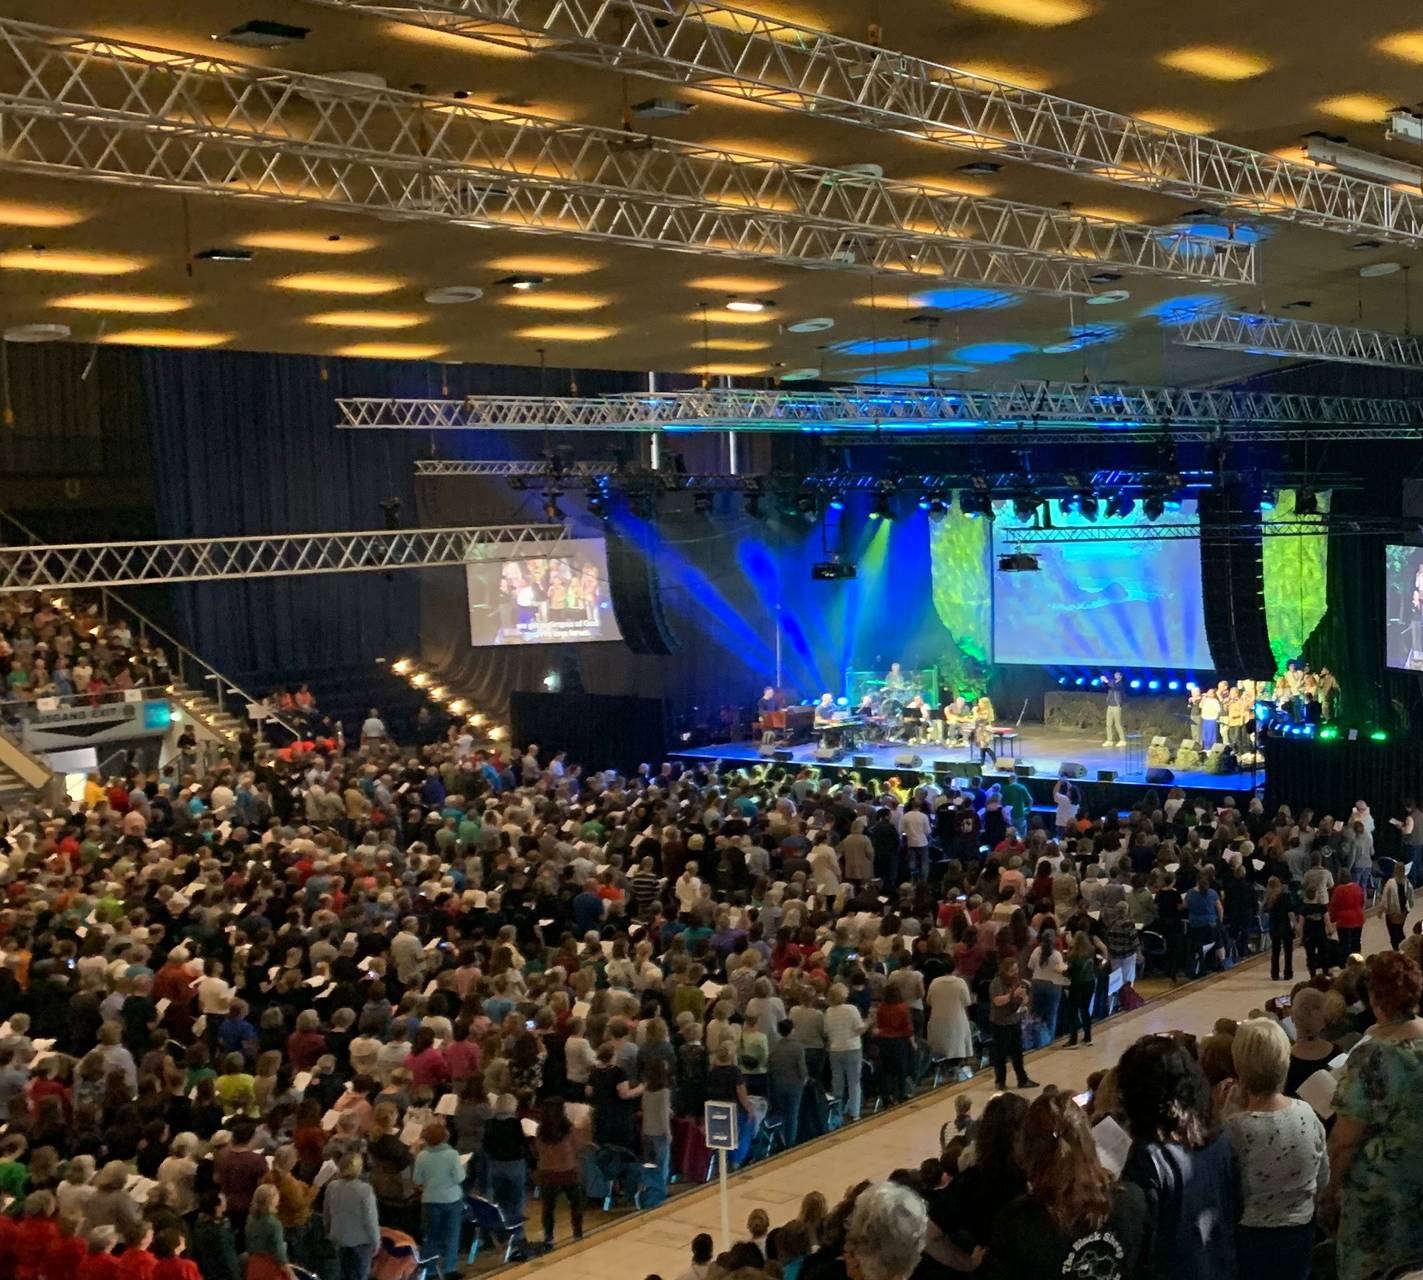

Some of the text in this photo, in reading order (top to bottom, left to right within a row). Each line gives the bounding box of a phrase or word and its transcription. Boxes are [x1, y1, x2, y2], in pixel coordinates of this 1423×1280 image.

[1061, 1231, 1124, 1275] The Black Sheep
